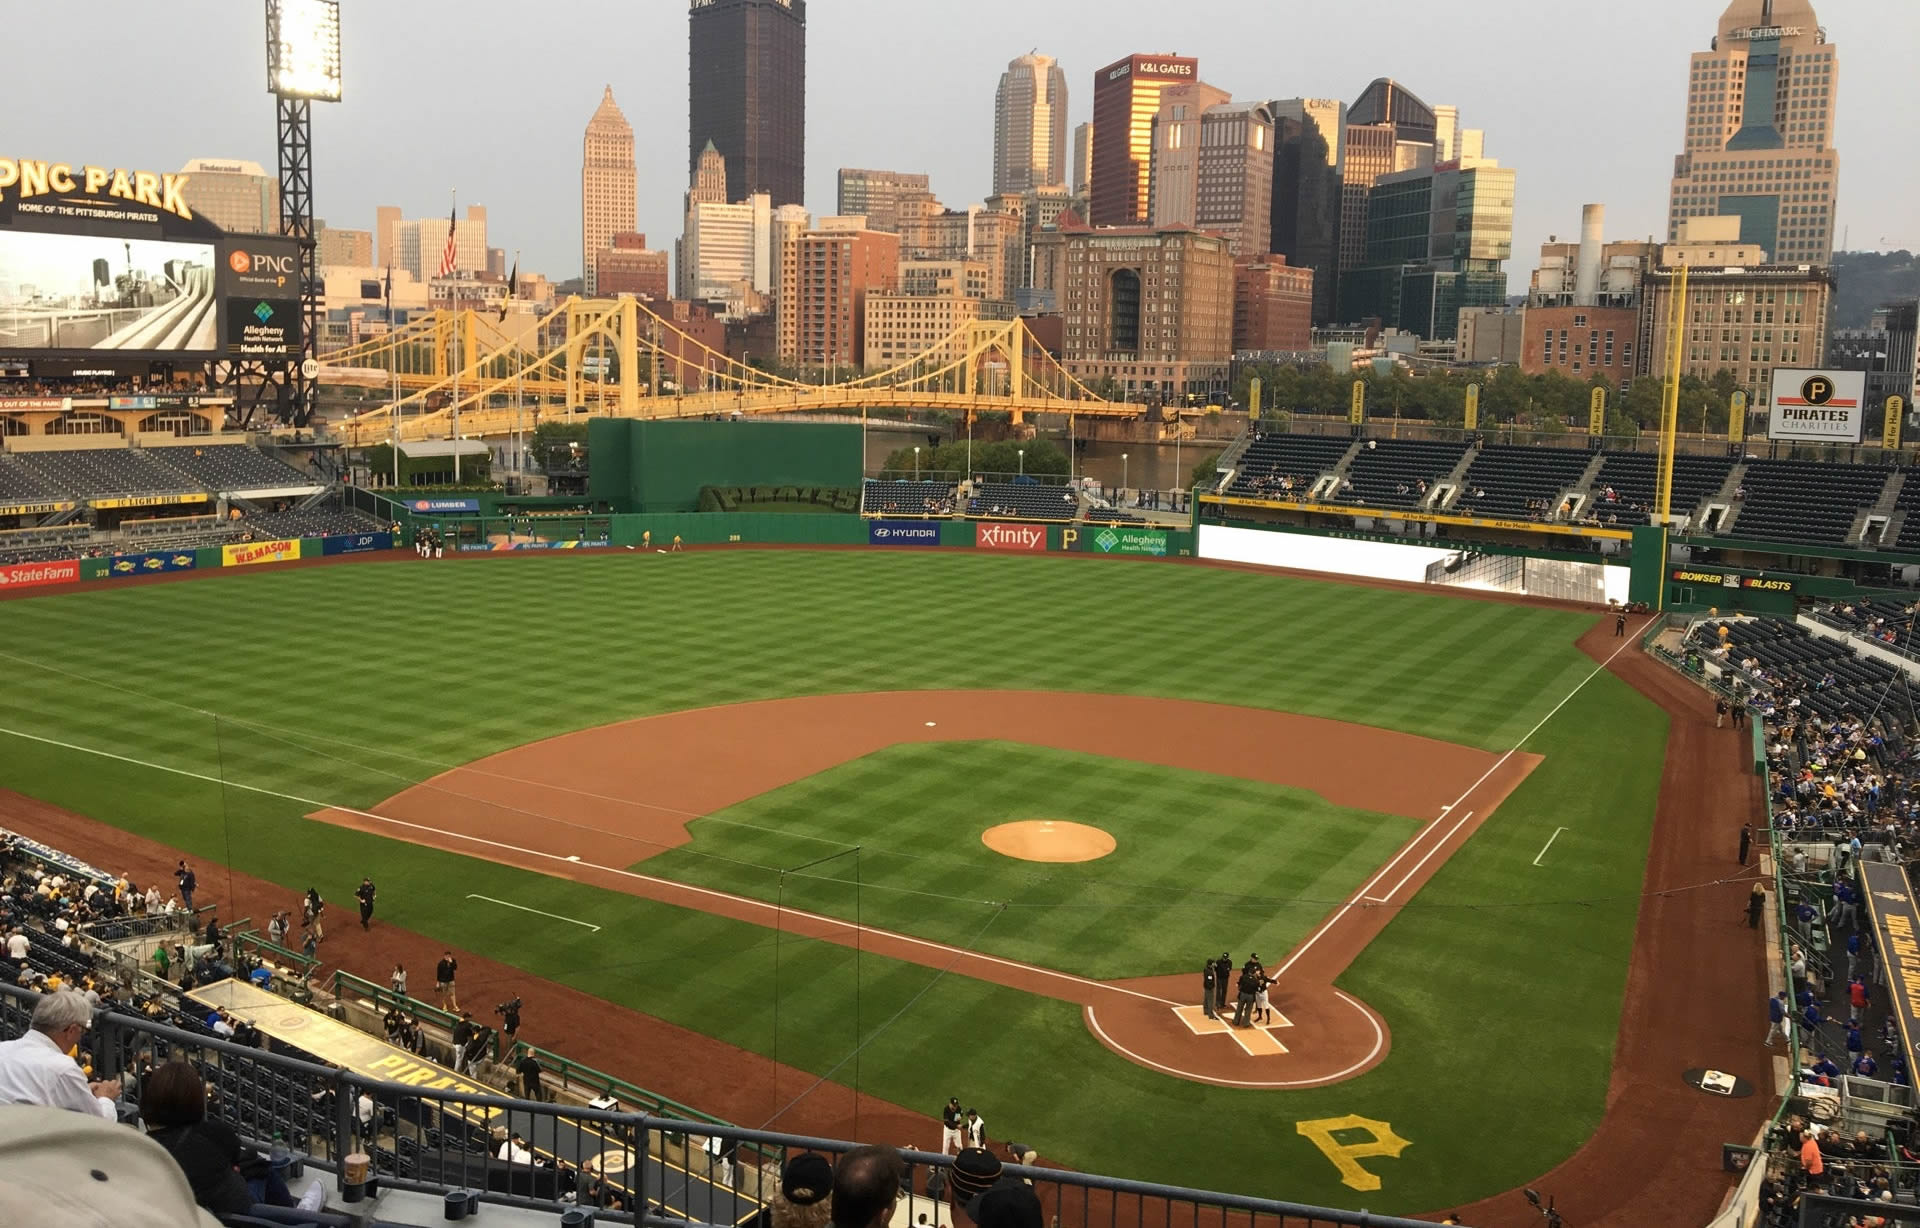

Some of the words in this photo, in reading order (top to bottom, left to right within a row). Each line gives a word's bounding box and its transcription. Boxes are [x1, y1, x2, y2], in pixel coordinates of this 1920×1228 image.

[1736, 26, 1800, 40] HIGHMARK
[1140, 62, 1159, 73] K&L
[1159, 63, 1192, 75] GATES
[0, 158, 77, 202] PNC
[84, 166, 193, 221] PARK
[18, 202, 43, 213] HOME
[44, 205, 57, 214] OF
[58, 206, 75, 216] THE
[75, 207, 126, 220] PITTSBURGH
[126, 211, 159, 222] PIRATES
[252, 255, 295, 273] PNC
[243, 325, 284, 337] Allegheny
[240, 344, 264, 353] Health
[265, 344, 276, 353] for
[276, 345, 287, 353] All
[1810, 382, 1826, 400] P
[1782, 408, 1849, 422] PIRATES
[1887, 400, 1900, 424] Health
[1781, 420, 1849, 431] CHARITIES
[1887, 427, 1897, 437] for
[1887, 438, 1896, 449] All
[129, 497, 158, 506] LIGHT
[161, 495, 182, 504] BEER
[431, 501, 466, 509] LUMBER
[0, 506, 21, 515] ITY
[25, 503, 56, 513] BEER
[1513, 522, 1531, 530] Health
[892, 529, 936, 538] HYUNDAI
[981, 525, 1042, 549] xfinity
[1063, 529, 1078, 549] P
[1122, 533, 1167, 546] Allegheny
[357, 536, 373, 546] JDP
[1329, 531, 1385, 542] WELCOME
[1418, 540, 1440, 548] PNC
[1450, 543, 1483, 551] PARK
[1680, 571, 1722, 584] BOWSER
[1751, 579, 1792, 591] BLASTS
[1296, 1113, 1414, 1192] P
